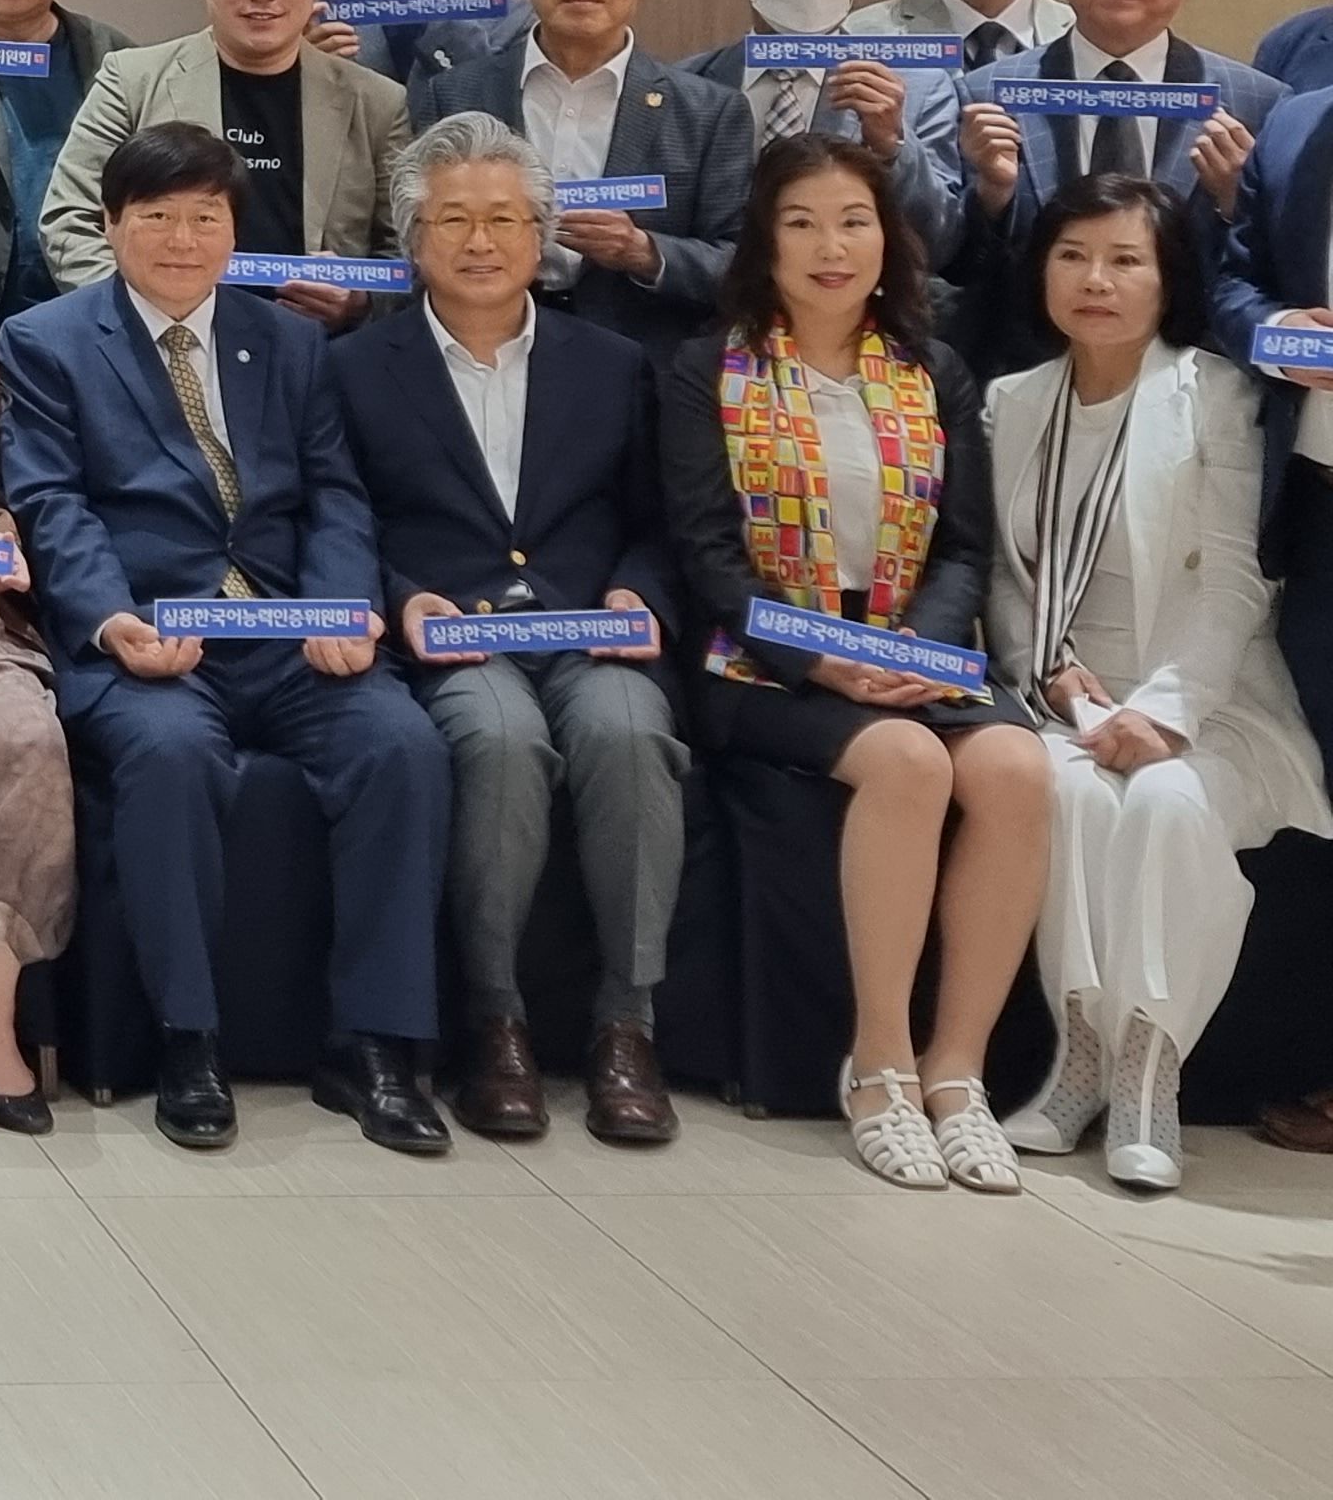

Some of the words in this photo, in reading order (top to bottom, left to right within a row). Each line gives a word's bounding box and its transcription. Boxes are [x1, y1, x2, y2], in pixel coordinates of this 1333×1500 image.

[751, 40, 943, 61] 실용한국어능력인증위원회
[1000, 85, 1198, 109] 실용한국어능력인증위원회
[226, 128, 265, 145] Club
[246, 157, 281, 170] smo
[162, 607, 351, 630] 실용한국어능력인증위원회
[430, 618, 631, 645] 실용한국어능력인증위원회
[755, 608, 964, 676] 실용한국어능력인증위원회
